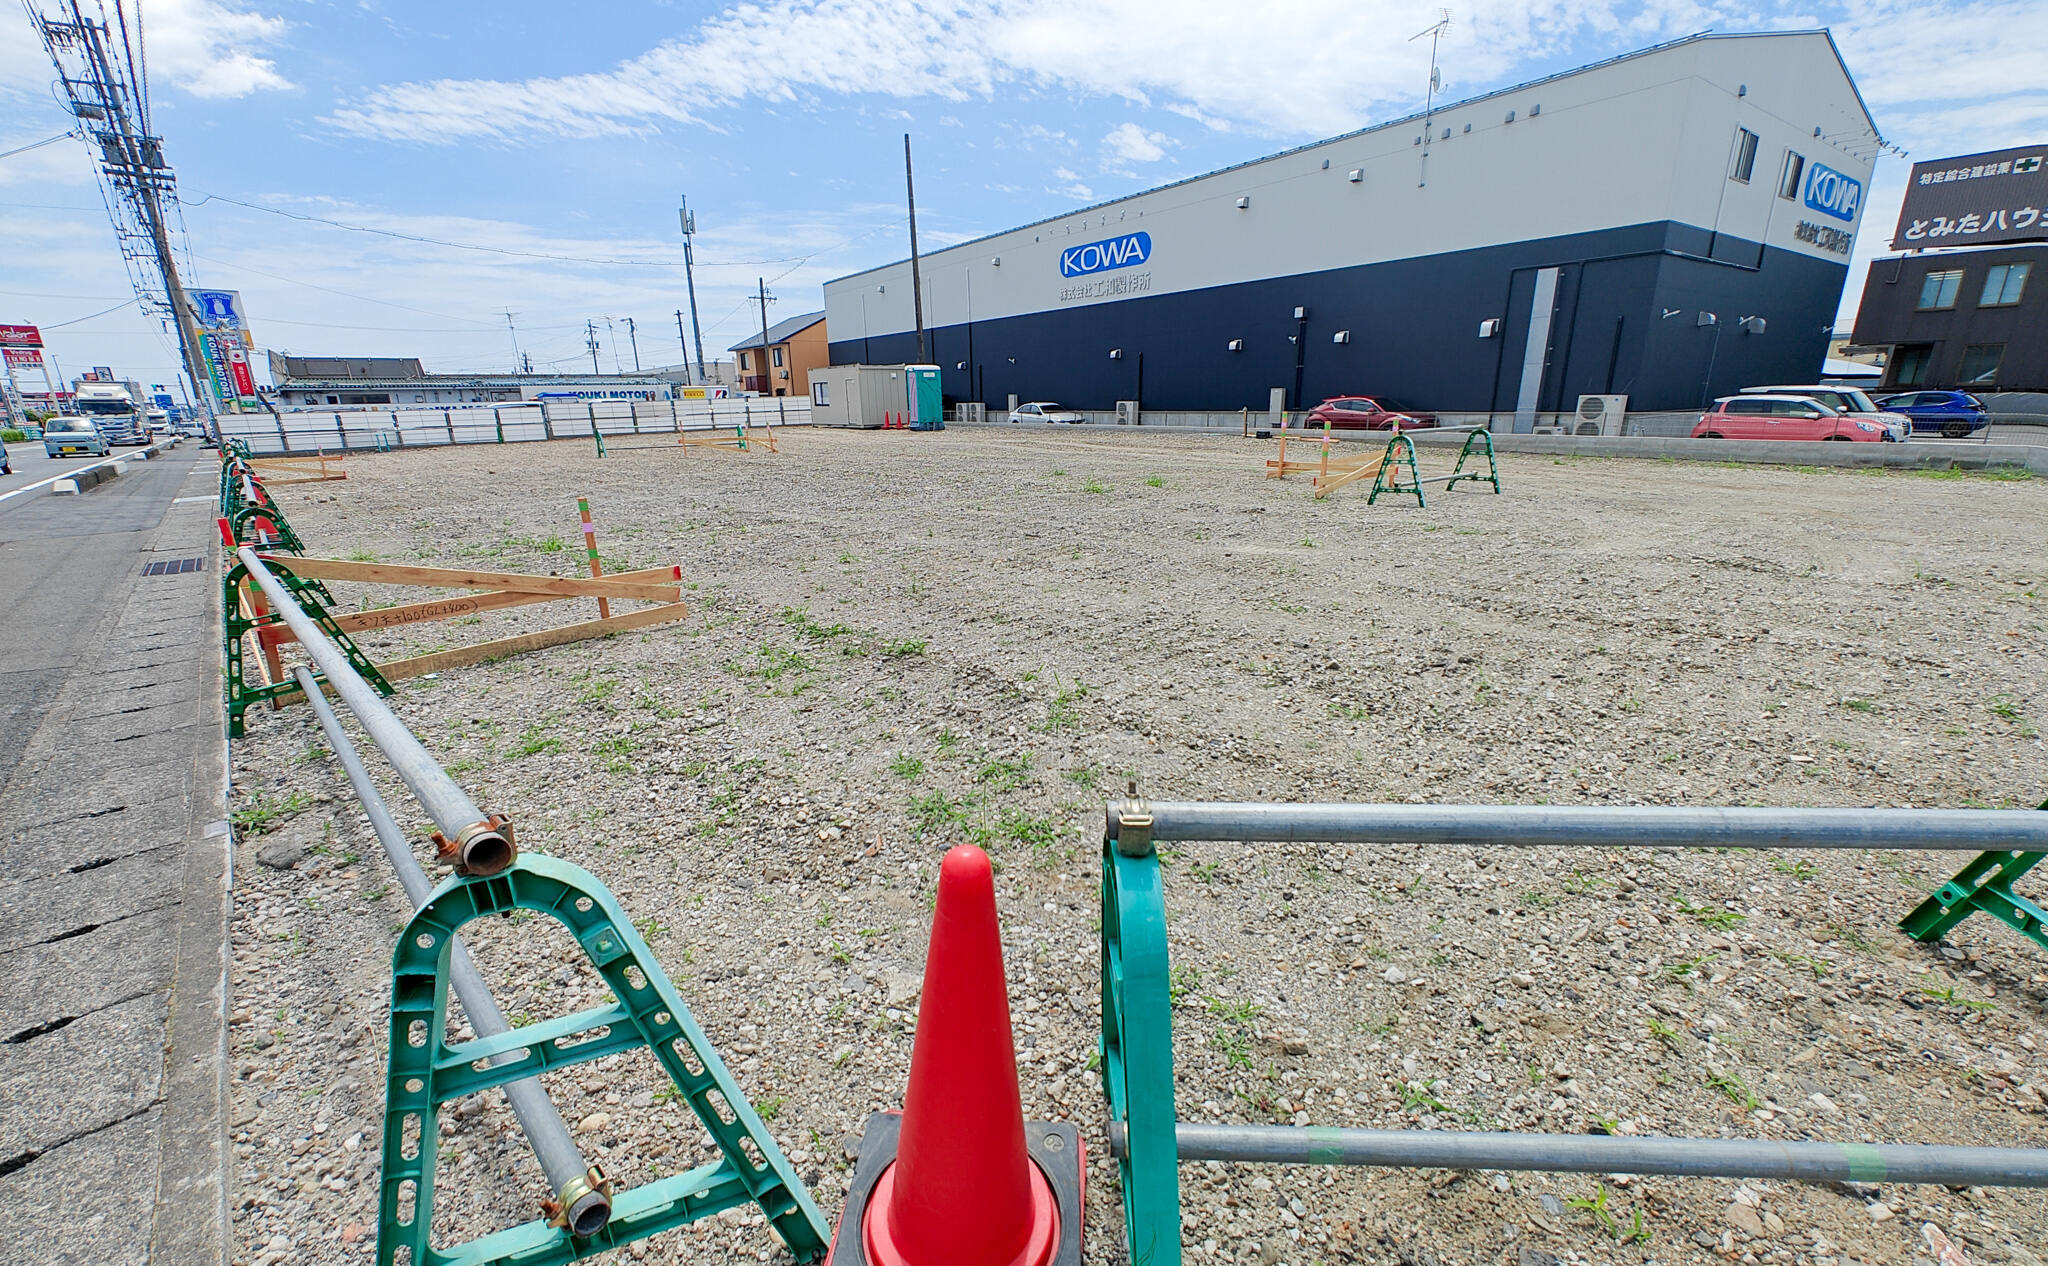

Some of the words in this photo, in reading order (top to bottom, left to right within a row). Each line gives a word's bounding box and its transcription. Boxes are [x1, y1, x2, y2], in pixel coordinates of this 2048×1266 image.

[1920, 161, 2011, 185] 特定総合建設業
[1807, 168, 1859, 216] KOWA
[1064, 237, 1144, 274] KOWA
[1060, 272, 1152, 301] 株式会社工和製作所
[206, 336, 220, 364] KOUKI
[214, 363, 232, 398] MOTORS
